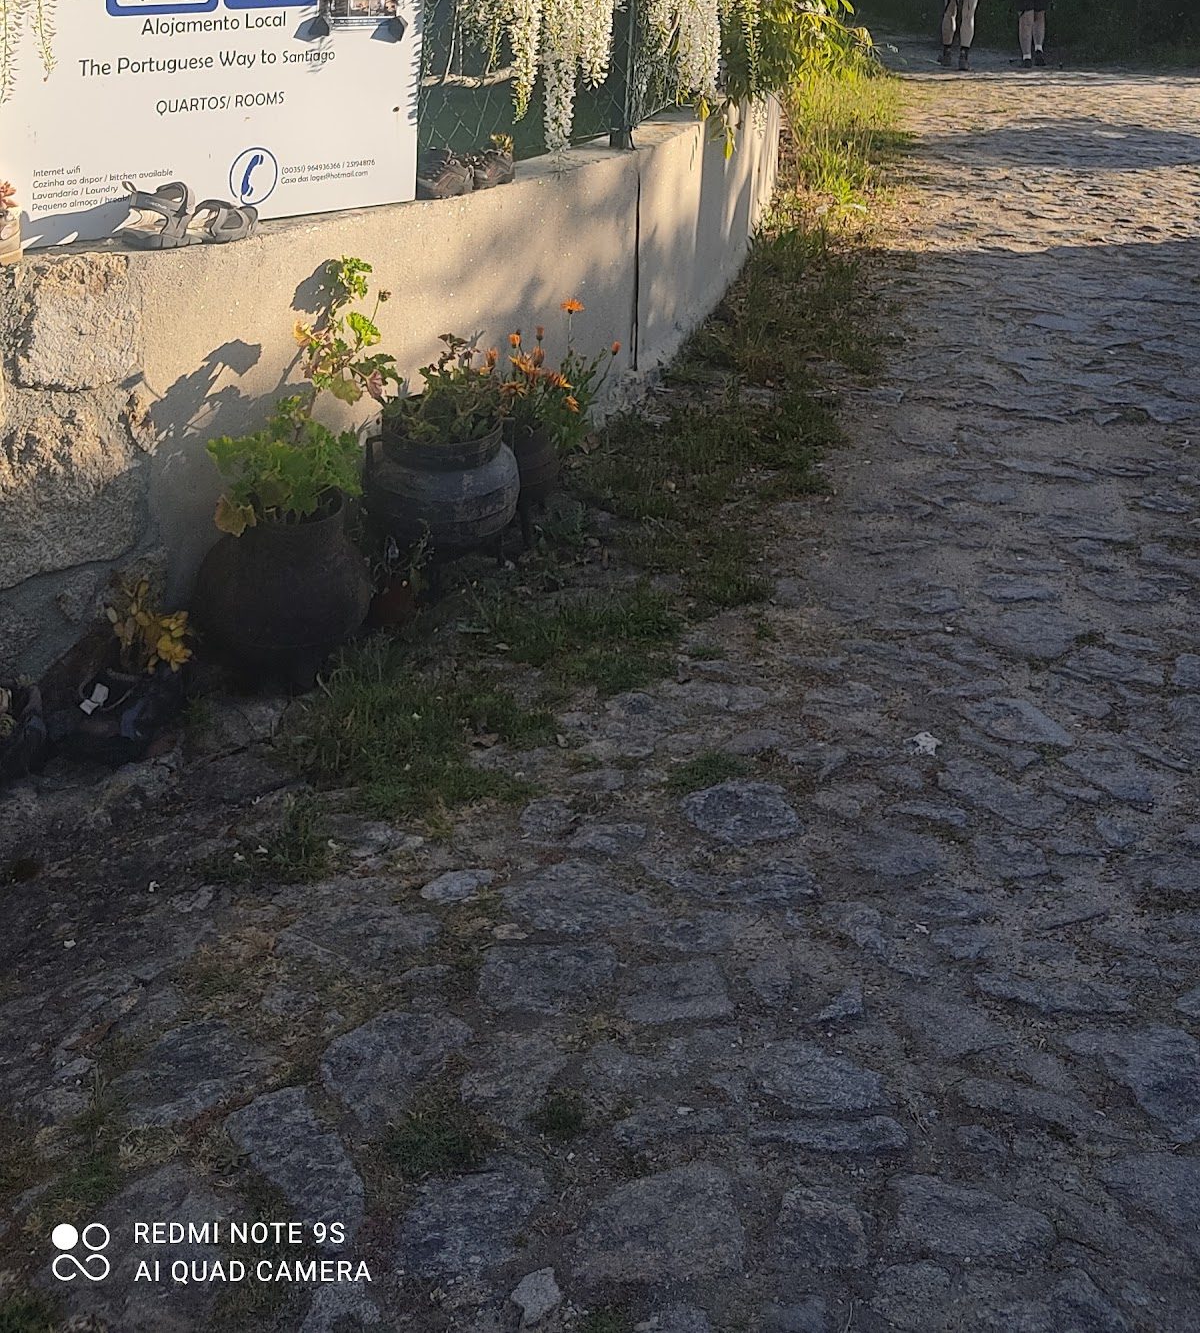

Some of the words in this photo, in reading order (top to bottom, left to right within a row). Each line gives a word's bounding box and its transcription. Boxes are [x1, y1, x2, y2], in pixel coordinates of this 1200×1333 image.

[141, 17, 240, 37] Alojamento
[245, 11, 287, 29] Local
[79, 59, 112, 77] The
[117, 54, 214, 75] Portuguese
[219, 50, 256, 68] Way
[261, 49, 277, 64] to
[282, 49, 336, 65] Santiago
[156, 95, 231, 116] QUARTOS/
[235, 91, 285, 109] ROOMS
[32, 178, 65, 189] Cozinha
[79, 176, 103, 186] dispor
[138, 168, 173, 179] available
[33, 167, 65, 177] Internet
[66, 165, 81, 175] wifi
[280, 176, 297, 185] Casa
[32, 189, 79, 201] Lavandaria
[85, 185, 119, 195] Laundry
[31, 202, 68, 212] Pequeno
[69, 198, 98, 209] almoço
